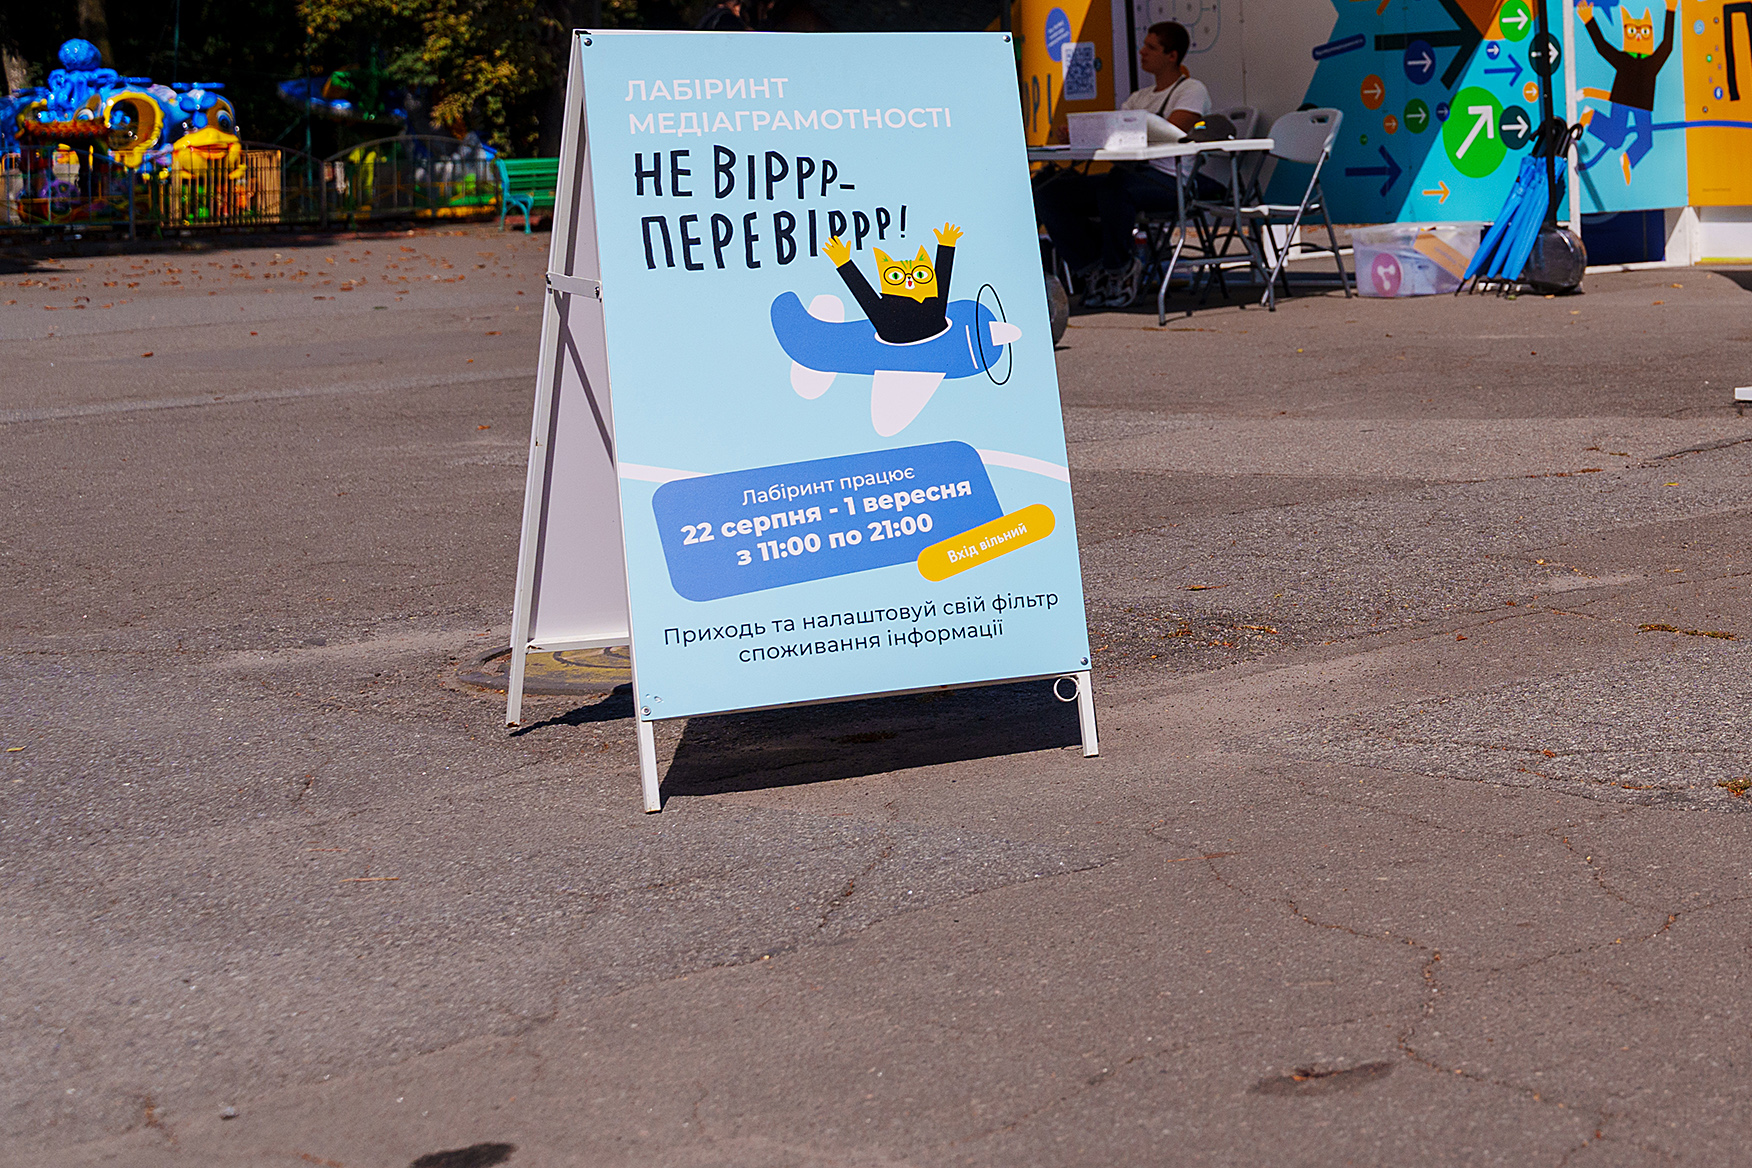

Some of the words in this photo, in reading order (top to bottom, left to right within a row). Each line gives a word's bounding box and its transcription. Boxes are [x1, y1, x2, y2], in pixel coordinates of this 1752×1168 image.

[625, 77, 789, 102] ЛАБІРИНТ
[628, 108, 952, 137] МЕДІАГРАМОТНОСТІ
[634, 149, 693, 197] НЕ
[640, 204, 909, 271] ПЕРЕВІРРР!
[741, 476, 835, 507] Лабіринт
[839, 465, 916, 494] працює
[680, 521, 714, 546] 22
[720, 504, 823, 540] серпня
[843, 496, 856, 517] 1
[864, 478, 973, 515] вересня
[735, 547, 753, 567] з
[756, 531, 822, 563] 11:00
[828, 526, 863, 550] по
[869, 513, 934, 542] 21:00
[946, 540, 979, 565] Вхід
[977, 521, 1029, 556] вільний
[664, 618, 767, 648] Приходь
[770, 614, 796, 633] та
[801, 599, 937, 633] налаштовуй
[942, 593, 986, 618] свій
[990, 589, 1060, 617] фільтр
[738, 633, 881, 664] споживання
[886, 618, 1004, 650] інформації
